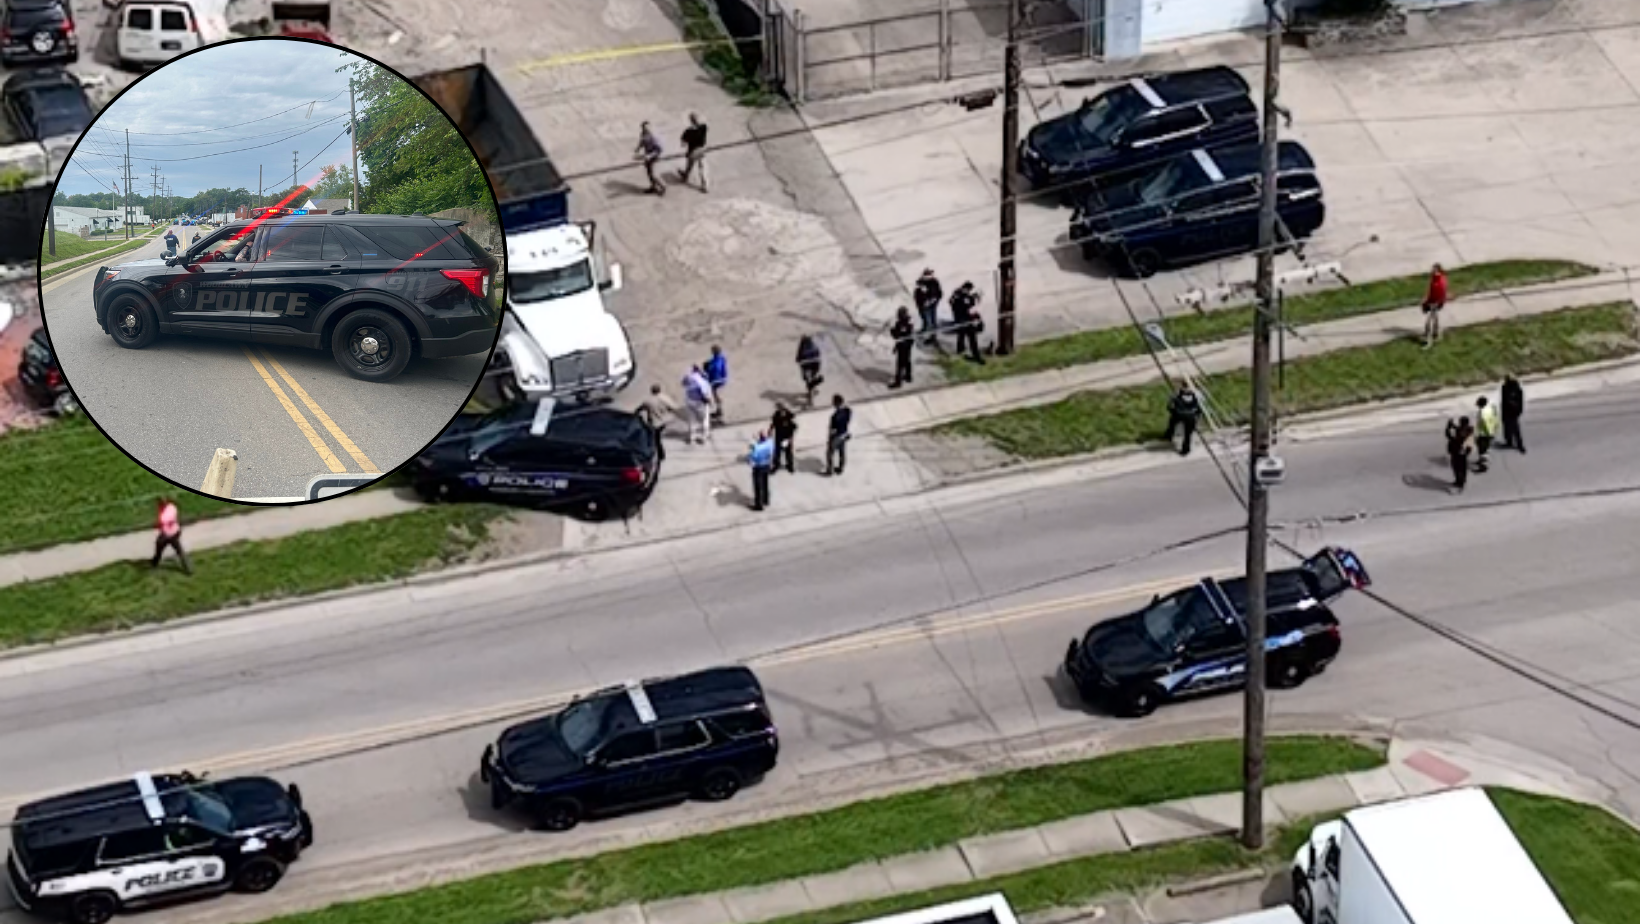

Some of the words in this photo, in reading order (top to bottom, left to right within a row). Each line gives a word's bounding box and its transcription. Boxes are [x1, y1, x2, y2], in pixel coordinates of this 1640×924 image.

[386, 276, 429, 291] 911
[194, 290, 310, 316] POLICE
[125, 866, 197, 892] POLICE
